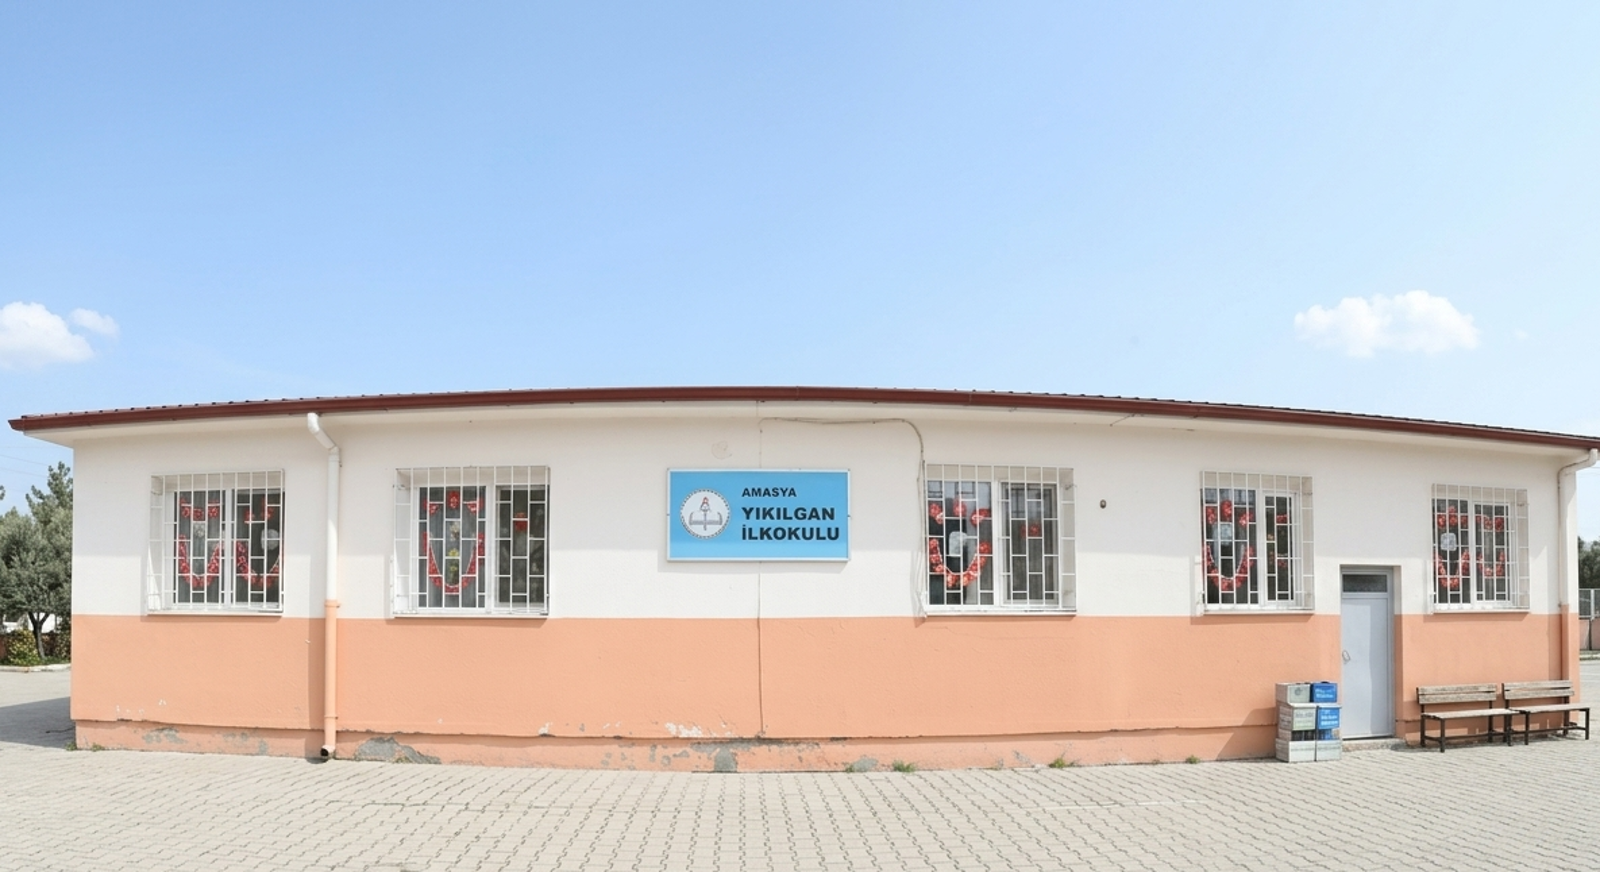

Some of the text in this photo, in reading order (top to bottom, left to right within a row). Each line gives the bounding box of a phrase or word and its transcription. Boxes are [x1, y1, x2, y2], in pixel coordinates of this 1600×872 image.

[741, 487, 797, 498] AMASYA
[741, 507, 836, 521] YIKILGAN
[742, 524, 840, 541] İLKOKULU
